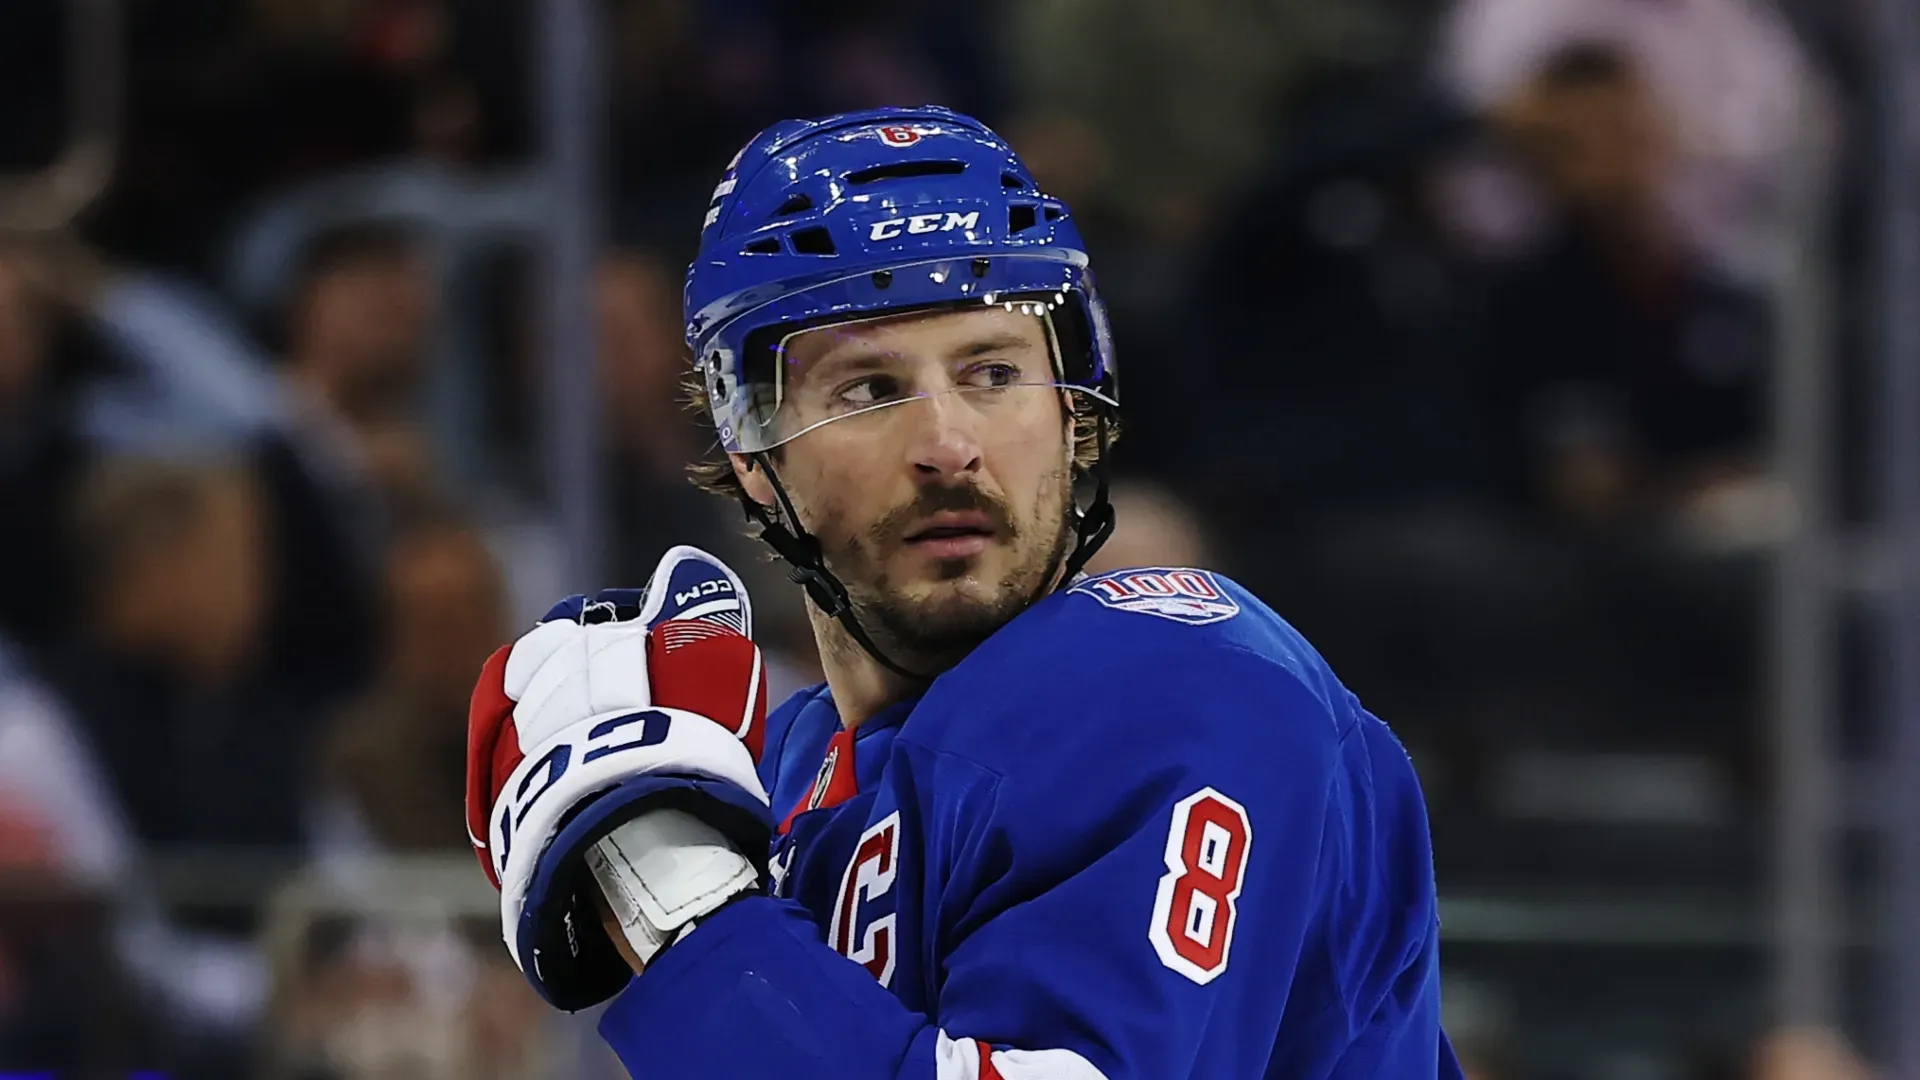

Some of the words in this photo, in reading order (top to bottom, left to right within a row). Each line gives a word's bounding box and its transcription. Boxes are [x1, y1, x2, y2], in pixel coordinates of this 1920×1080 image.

[869, 212, 980, 241] CCM
[674, 579, 733, 607] CCM
[1092, 571, 1220, 601] 100
[828, 810, 900, 988] C
[1148, 786, 1252, 985] 8
